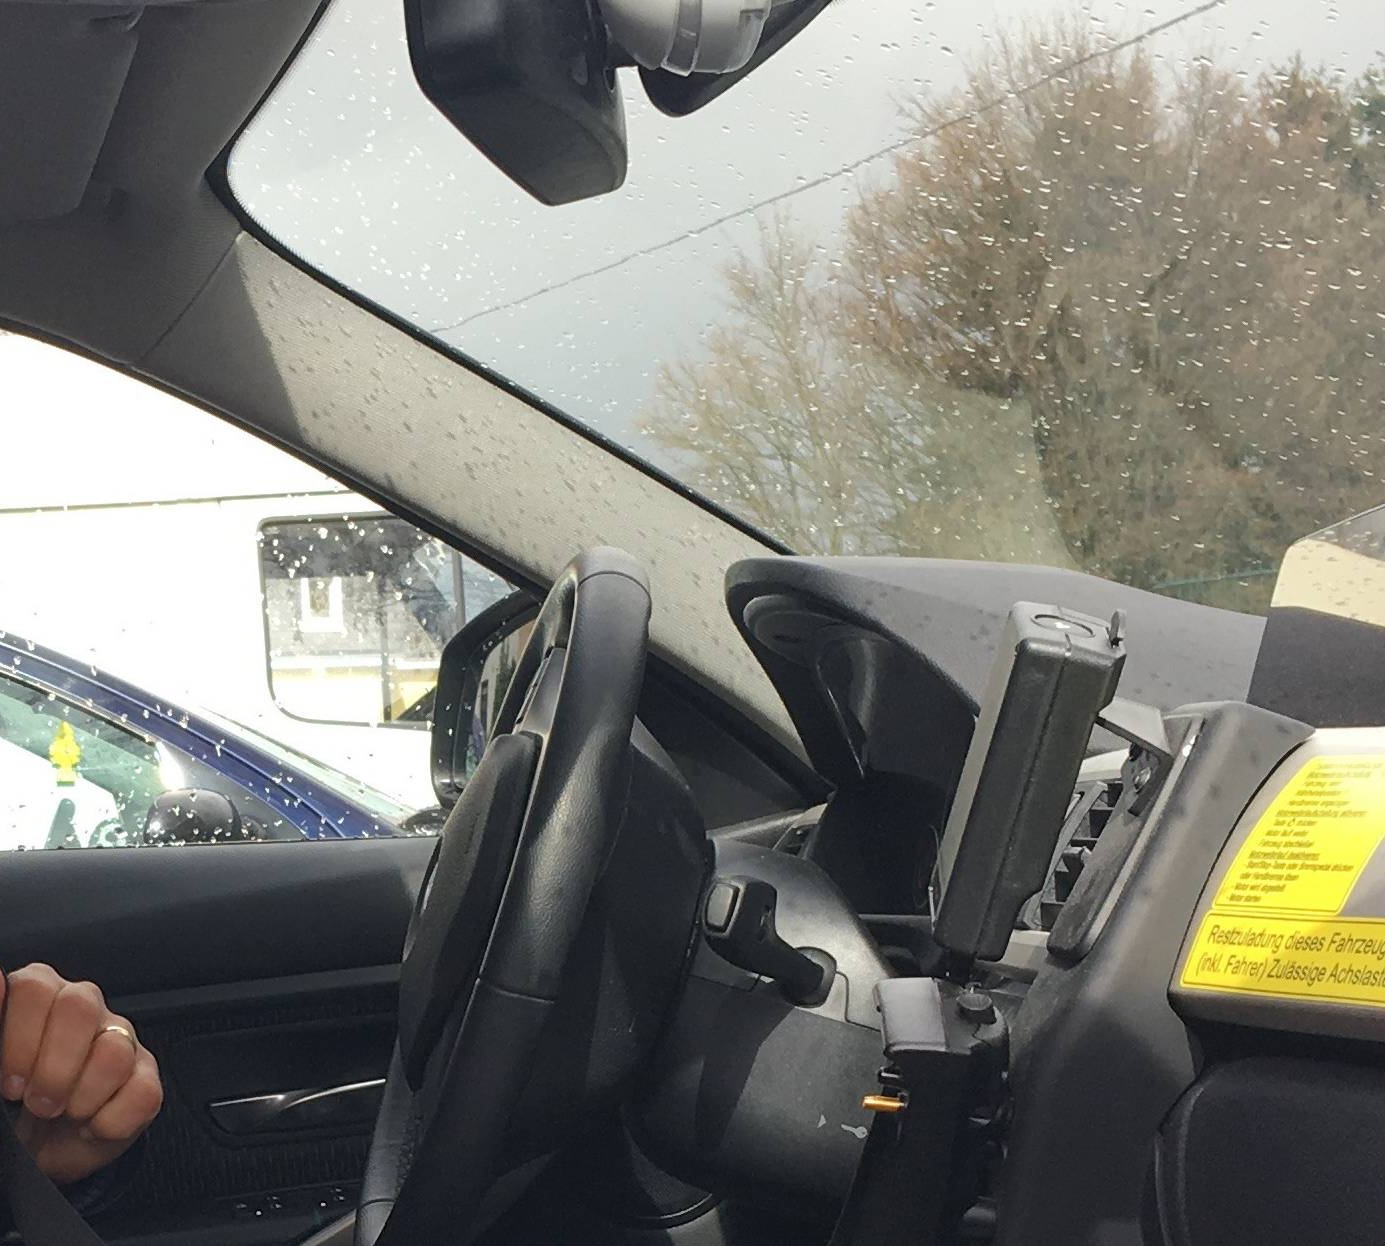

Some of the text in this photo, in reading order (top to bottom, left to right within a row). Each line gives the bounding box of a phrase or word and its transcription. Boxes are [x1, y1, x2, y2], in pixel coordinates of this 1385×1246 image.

[1207, 924, 1284, 953] Restzuladung
[1285, 930, 1325, 951] dieses
[1196, 952, 1222, 976] (inkl.
[1225, 955, 1268, 982] Fahrer)
[1267, 959, 1327, 987] Zulässige
